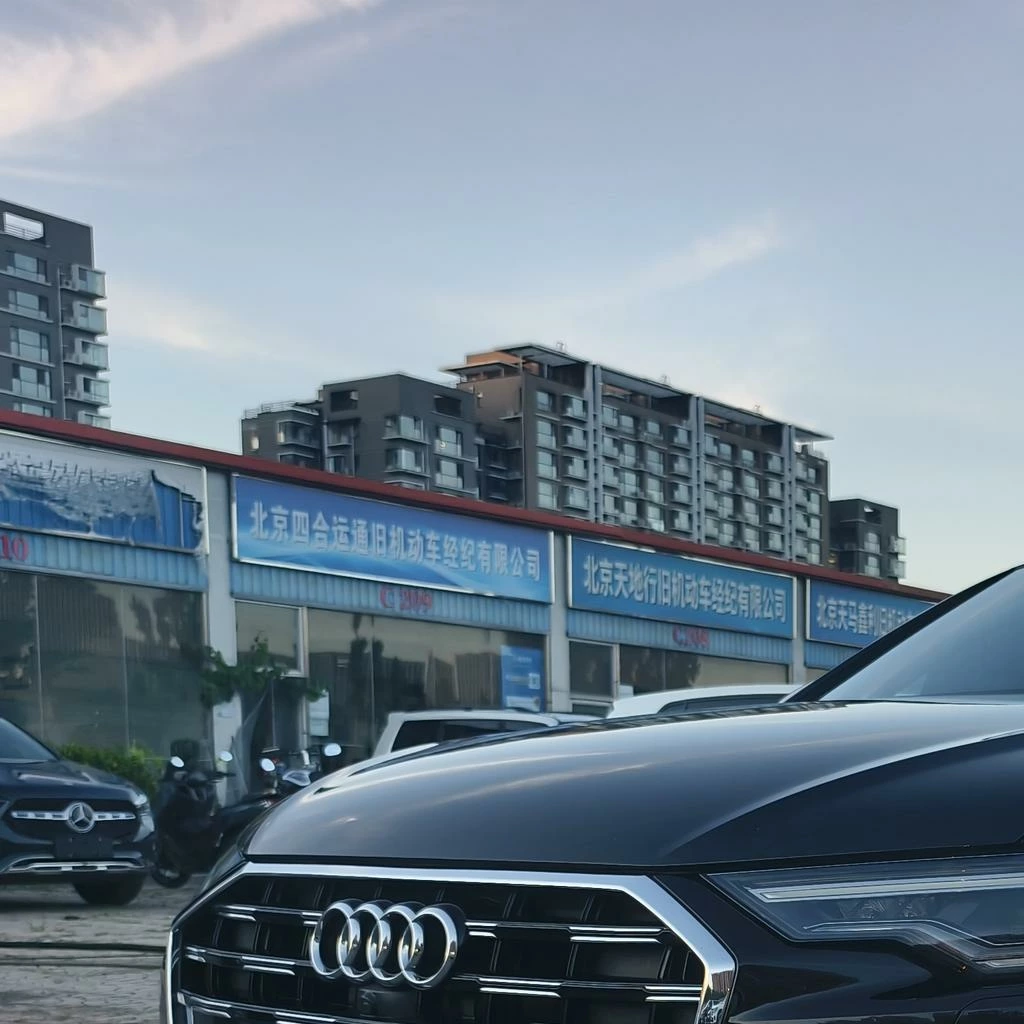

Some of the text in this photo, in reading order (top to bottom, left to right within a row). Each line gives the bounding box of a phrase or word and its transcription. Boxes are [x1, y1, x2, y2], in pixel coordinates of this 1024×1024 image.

[250, 500, 541, 582] 北京四合运通旧机动车经纪有限公司
[583, 554, 787, 624] 北京天地行旧机动车经纪有限公司
